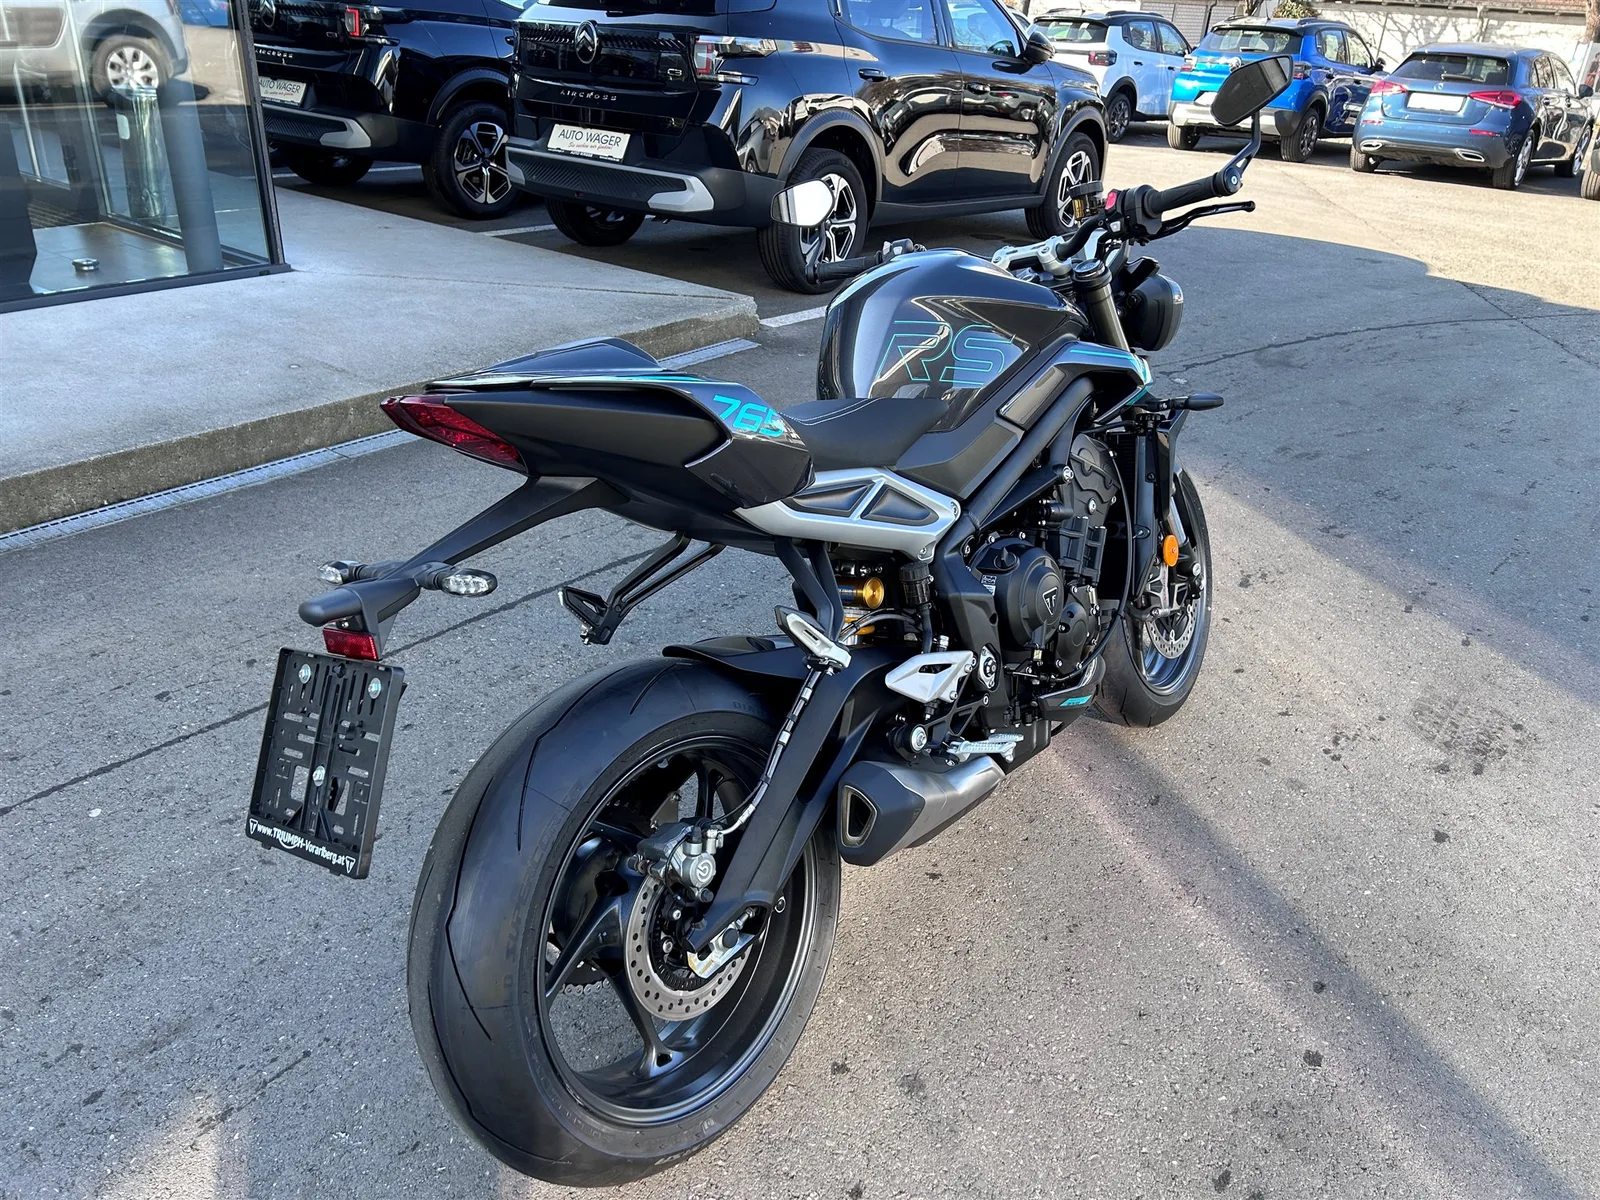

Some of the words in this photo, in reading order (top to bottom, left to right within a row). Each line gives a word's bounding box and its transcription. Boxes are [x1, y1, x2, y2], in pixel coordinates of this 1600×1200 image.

[560, 89, 617, 101] AIRCROSS
[558, 129, 583, 141] AUTO
[875, 320, 1015, 385] RS
[712, 394, 785, 437] 765
